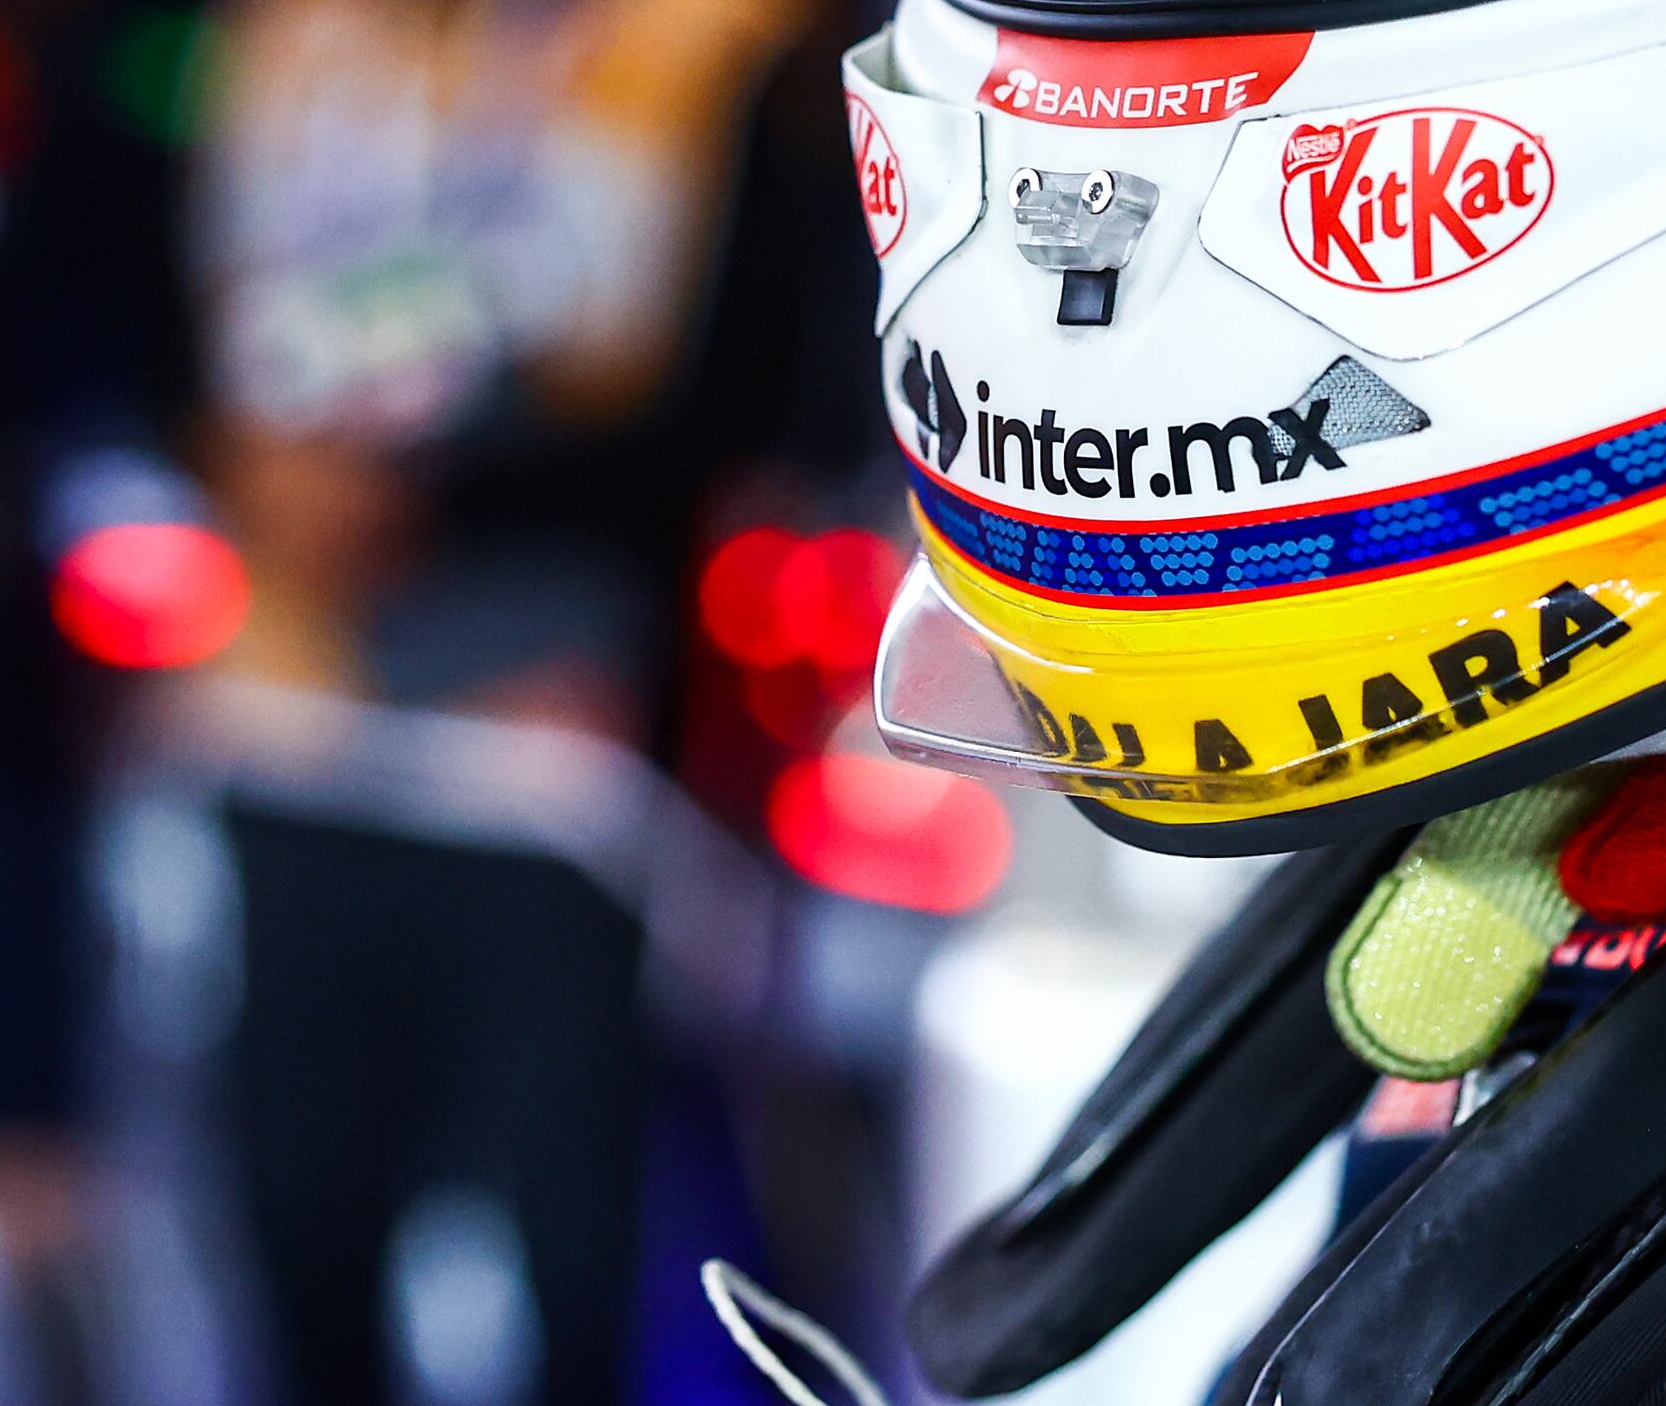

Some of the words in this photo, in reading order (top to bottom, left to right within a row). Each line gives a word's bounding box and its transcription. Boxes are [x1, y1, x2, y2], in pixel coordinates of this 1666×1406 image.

[1035, 71, 1259, 119] BANORTE
[1309, 117, 1536, 284] KitKat
[976, 379, 1348, 499] inter.mx
